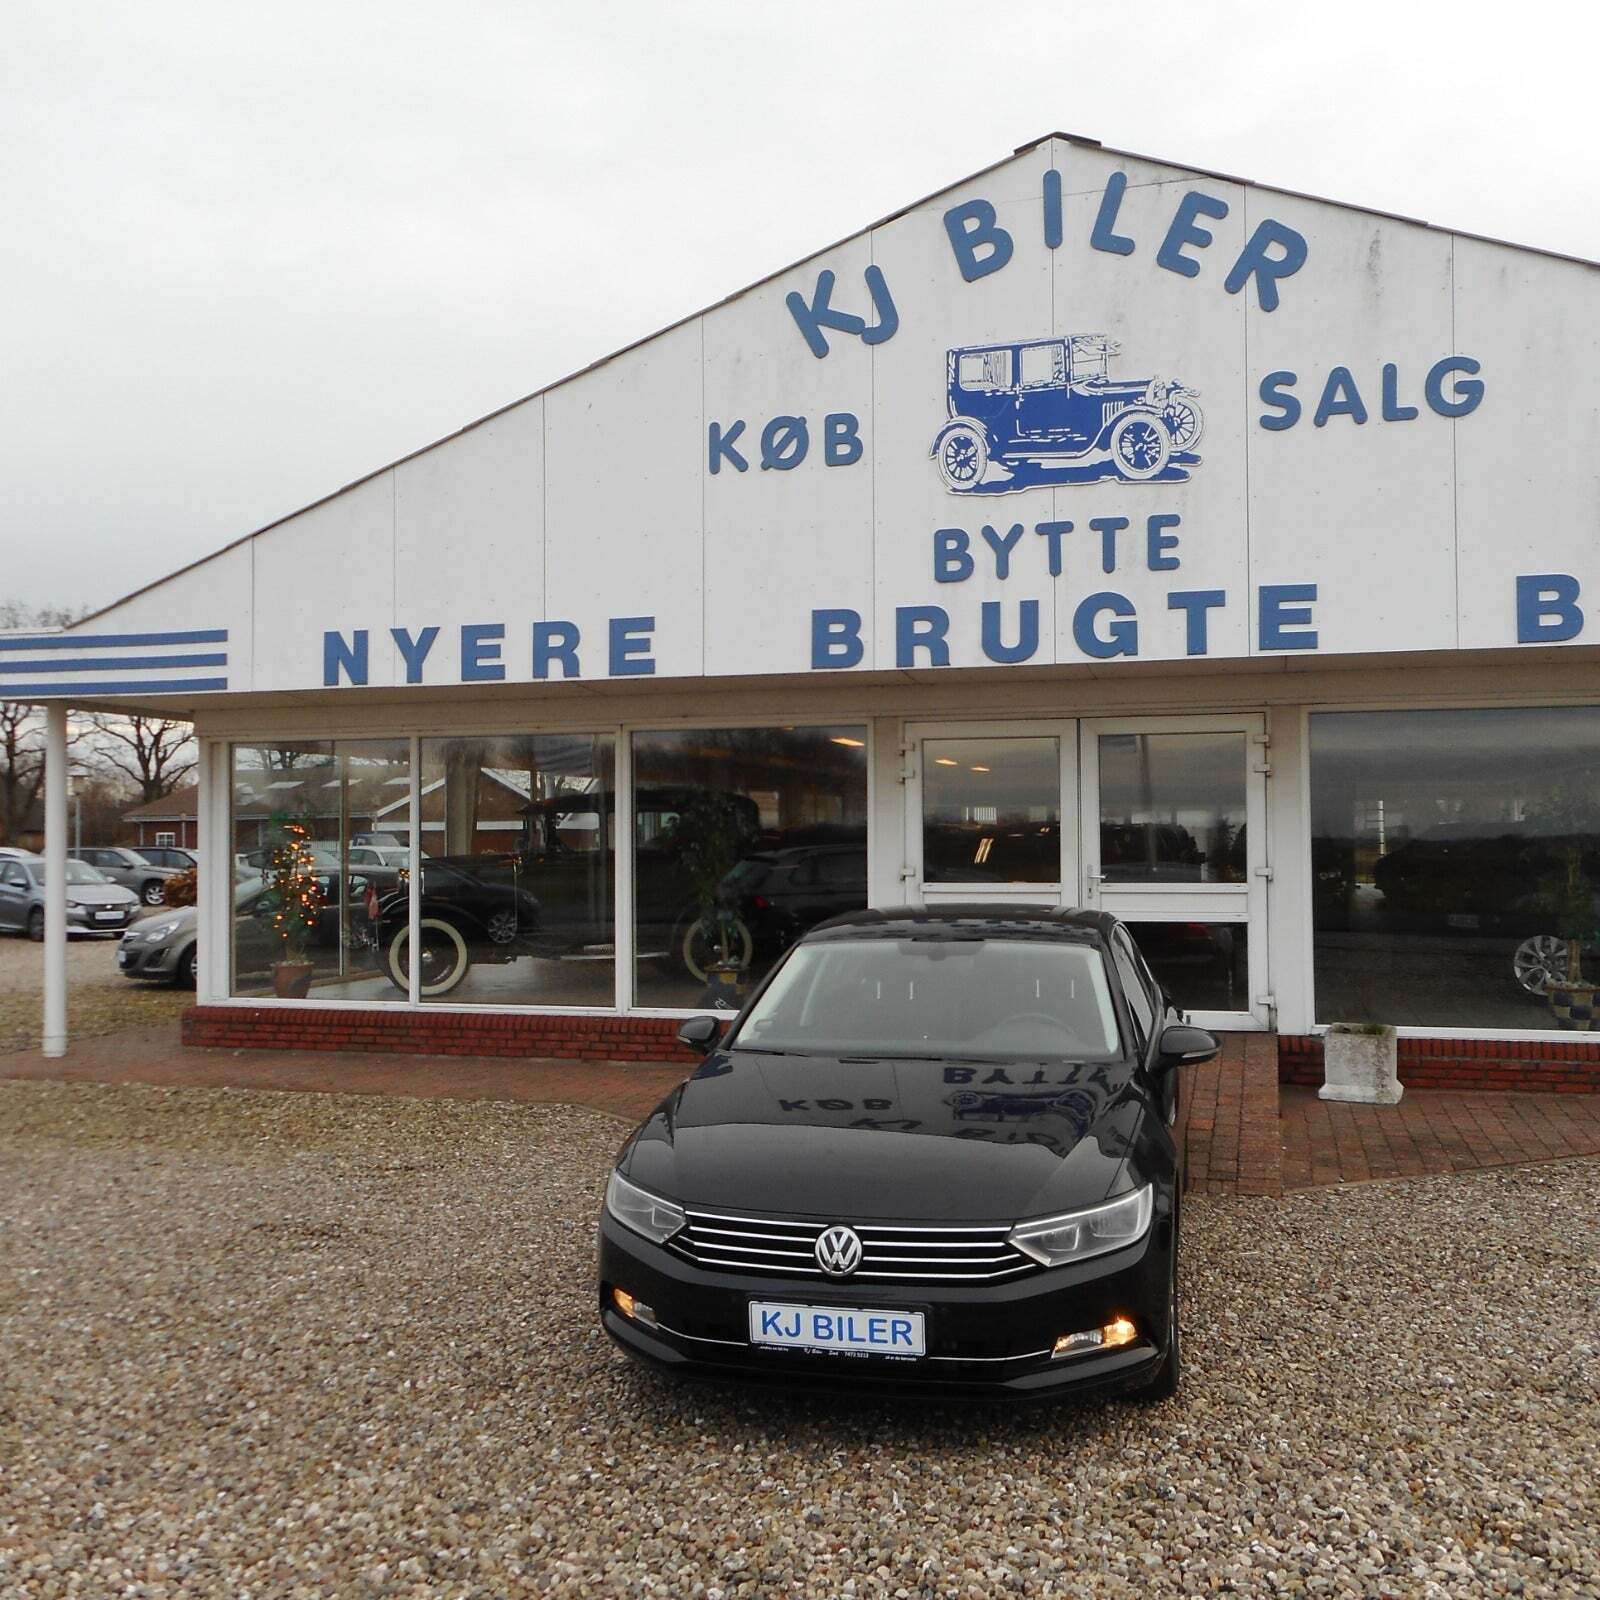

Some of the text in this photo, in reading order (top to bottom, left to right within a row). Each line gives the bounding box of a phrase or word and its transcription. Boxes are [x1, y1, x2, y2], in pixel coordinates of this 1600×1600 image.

[786, 169, 1309, 358] KJ BILER
[1259, 355, 1486, 432] SALG
[708, 412, 864, 475] KØB
[934, 513, 1182, 583] BYTTE
[323, 616, 656, 690] NYERE
[811, 583, 1319, 671] BRUGTE
[760, 1310, 914, 1347] KJ BILER
